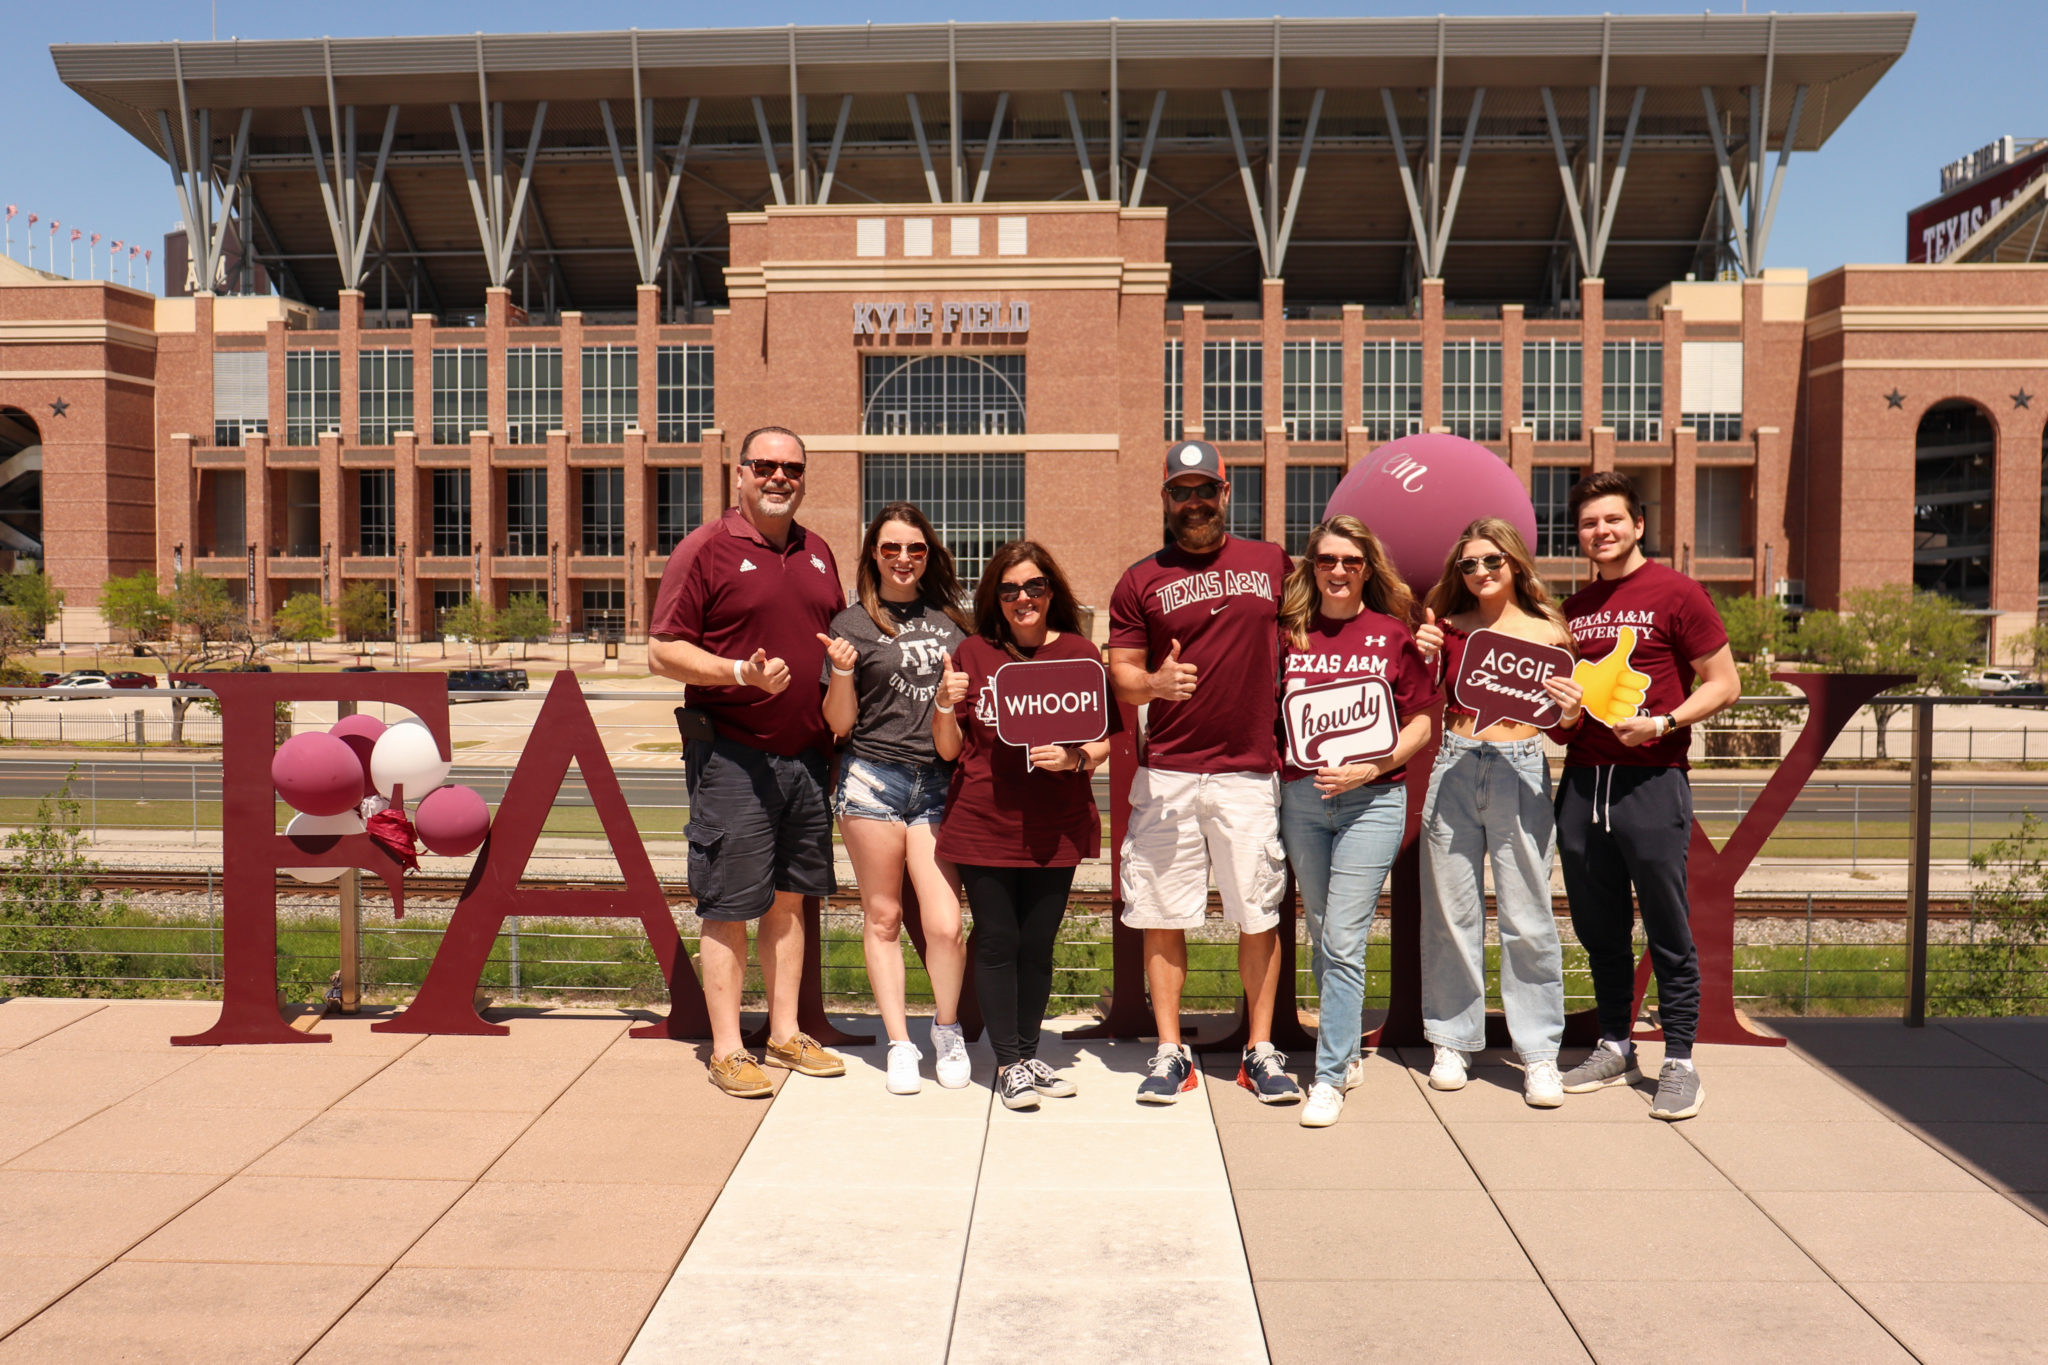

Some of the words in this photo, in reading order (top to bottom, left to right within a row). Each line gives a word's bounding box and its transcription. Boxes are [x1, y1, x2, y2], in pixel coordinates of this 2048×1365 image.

[853, 303, 933, 335] KYLE
[942, 302, 1030, 333] FIELD
[1155, 571, 1223, 615] TEXAS
[1225, 569, 1274, 602] A&M
[877, 620, 916, 645] TEAS
[920, 621, 951, 639] A&M
[1614, 610, 1655, 625] A&M
[1285, 653, 1342, 674] EXAS
[1344, 654, 1388, 678] A&M
[1480, 648, 1556, 685] AGGIE
[1004, 691, 1099, 717] WHOOP!
[1466, 669, 1556, 718] Family
[1301, 685, 1381, 740] howdy
